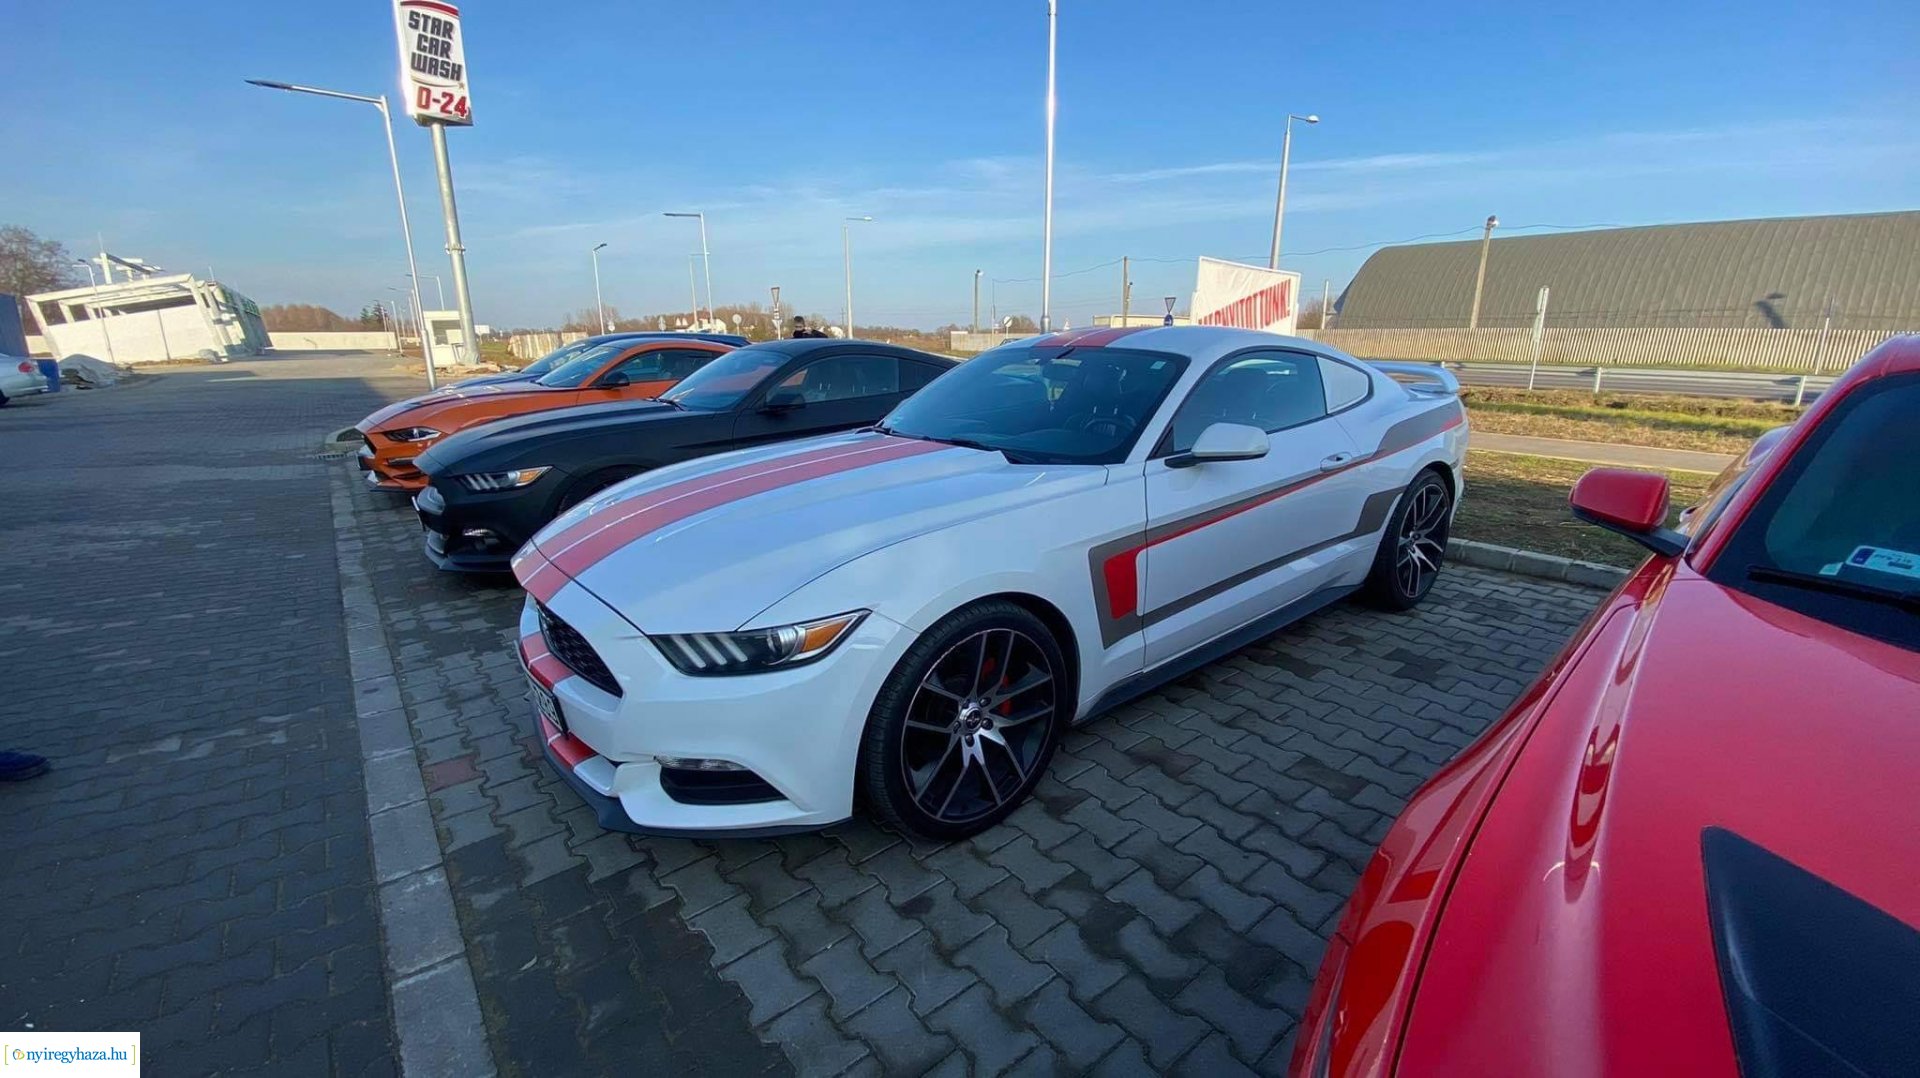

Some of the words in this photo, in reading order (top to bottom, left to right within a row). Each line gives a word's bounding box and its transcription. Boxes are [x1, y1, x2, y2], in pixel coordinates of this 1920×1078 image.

[408, 10, 454, 40] STAR
[416, 33, 452, 59] CAR
[410, 52, 463, 82] WASH
[417, 86, 468, 117] 0-24
[1198, 278, 1291, 330] YITOTTUNK!
